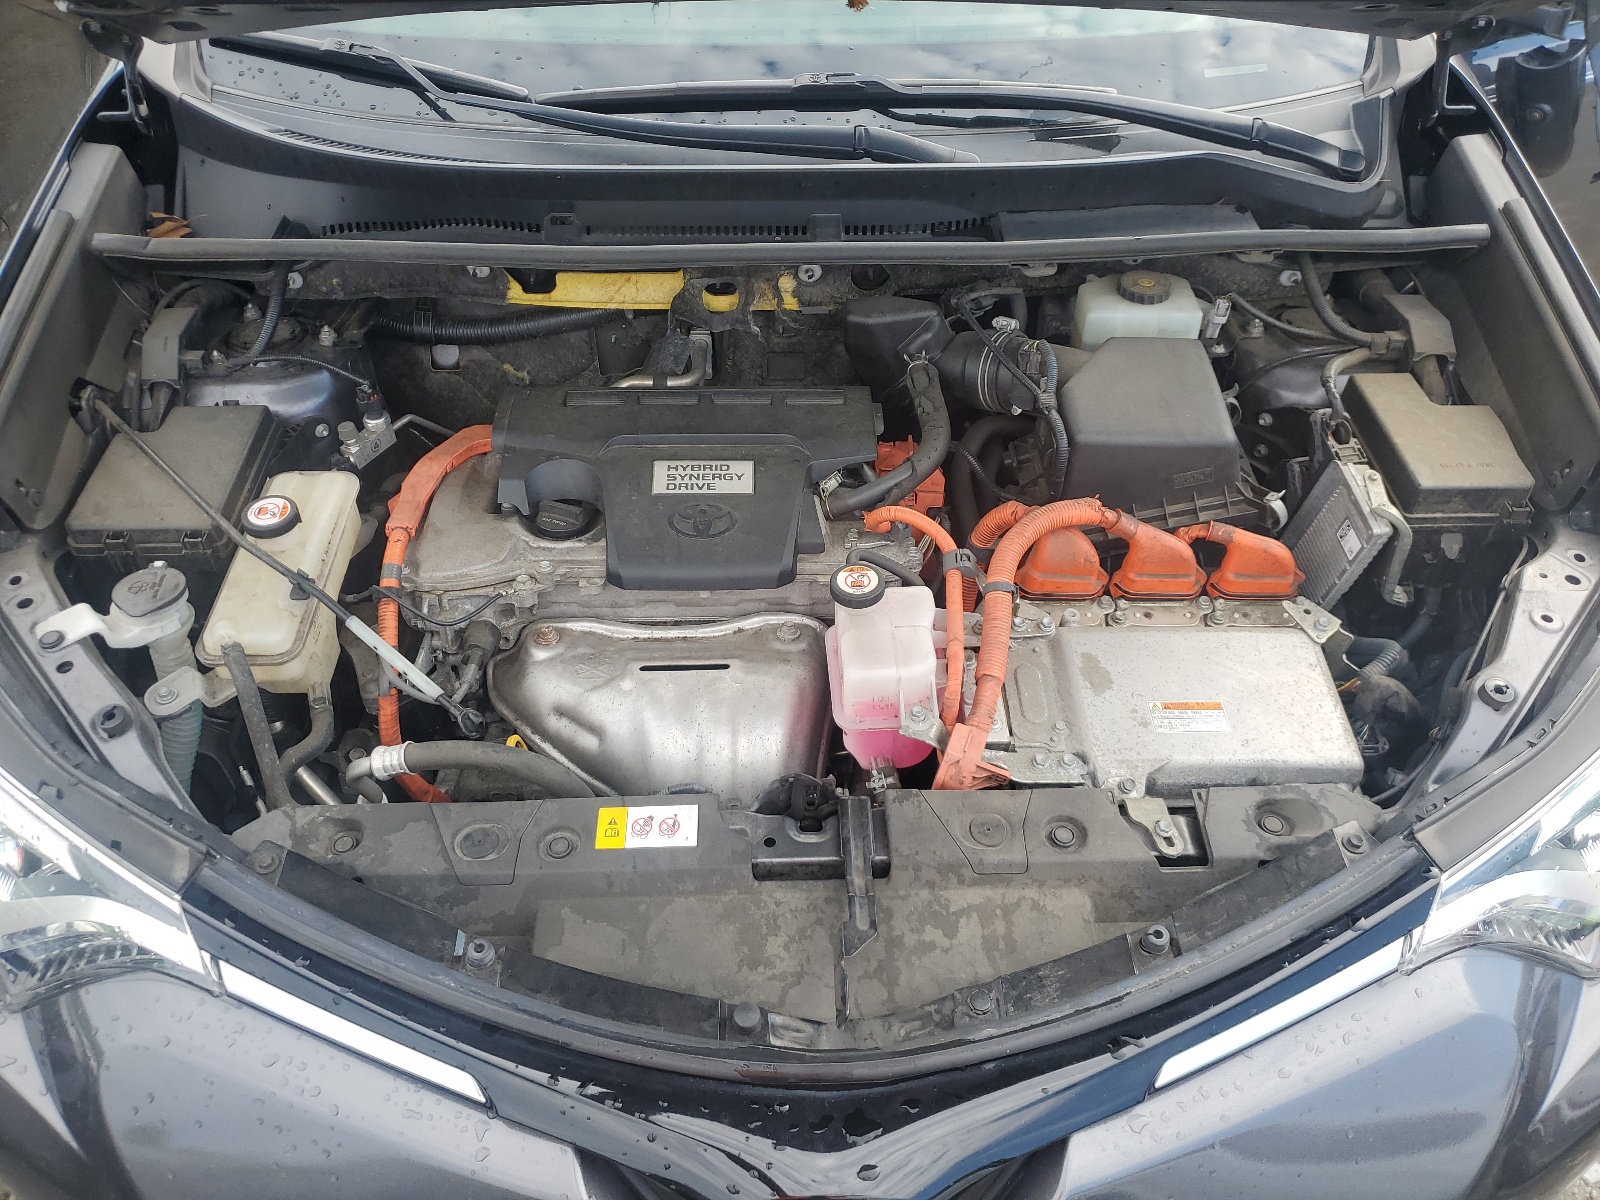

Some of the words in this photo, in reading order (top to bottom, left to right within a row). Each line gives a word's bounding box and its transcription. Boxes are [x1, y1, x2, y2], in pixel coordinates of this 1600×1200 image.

[667, 464, 731, 472] HYBRID
[666, 473, 745, 481] SYNERGY
[666, 482, 717, 491] DRIVE
